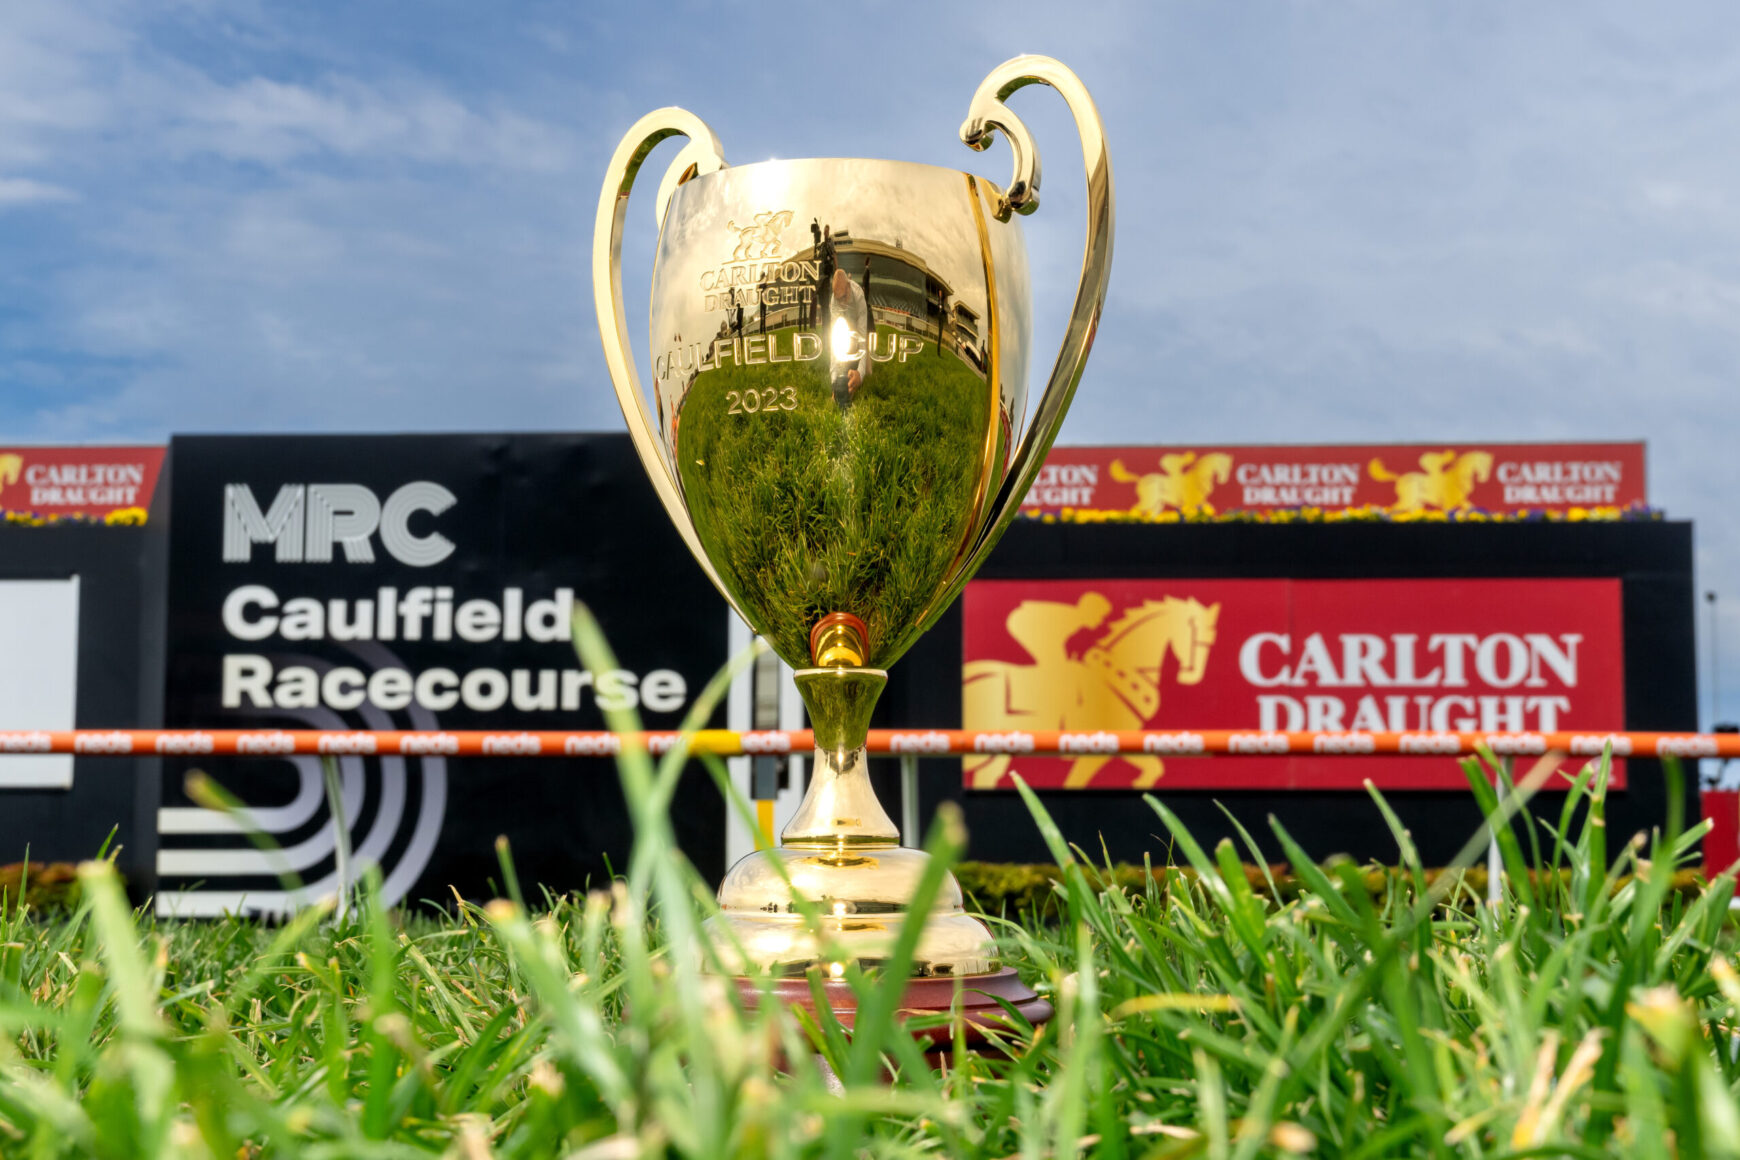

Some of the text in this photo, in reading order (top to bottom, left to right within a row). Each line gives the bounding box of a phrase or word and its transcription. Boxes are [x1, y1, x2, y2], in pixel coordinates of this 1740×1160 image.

[699, 260, 822, 292] CARLTON
[704, 284, 816, 313] DRAUGHT
[655, 331, 925, 381] CAULFIELD CUP
[725, 386, 799, 415] 2023
[25, 463, 145, 487] CARLTON
[1236, 463, 1361, 486] CARLTON
[1496, 460, 1623, 485] CARLTON
[30, 486, 140, 506] DRAUGHT
[1242, 486, 1357, 506] DRAUGHT
[1503, 483, 1619, 505] DRAUGHT
[222, 480, 458, 567] MRC
[222, 584, 575, 642] Caulfield
[1238, 632, 1583, 688] CARLTON
[222, 654, 687, 712] Racecourse
[1256, 694, 1571, 733] DRAUGHT
[75, 731, 133, 753] neds
[155, 731, 214, 753] neds
[236, 731, 295, 753] neds
[318, 731, 377, 754] neds
[401, 731, 459, 754] neds
[482, 732, 541, 754] neds
[890, 731, 950, 753] neds
[974, 731, 1034, 753] neds
[1058, 731, 1118, 753] neds
[1143, 731, 1204, 753] neds
[1228, 731, 1289, 753] neds
[1313, 731, 1375, 753] neds
[1399, 732, 1460, 754] neds
[1485, 732, 1546, 755] neds
[1655, 735, 1718, 757] neds
